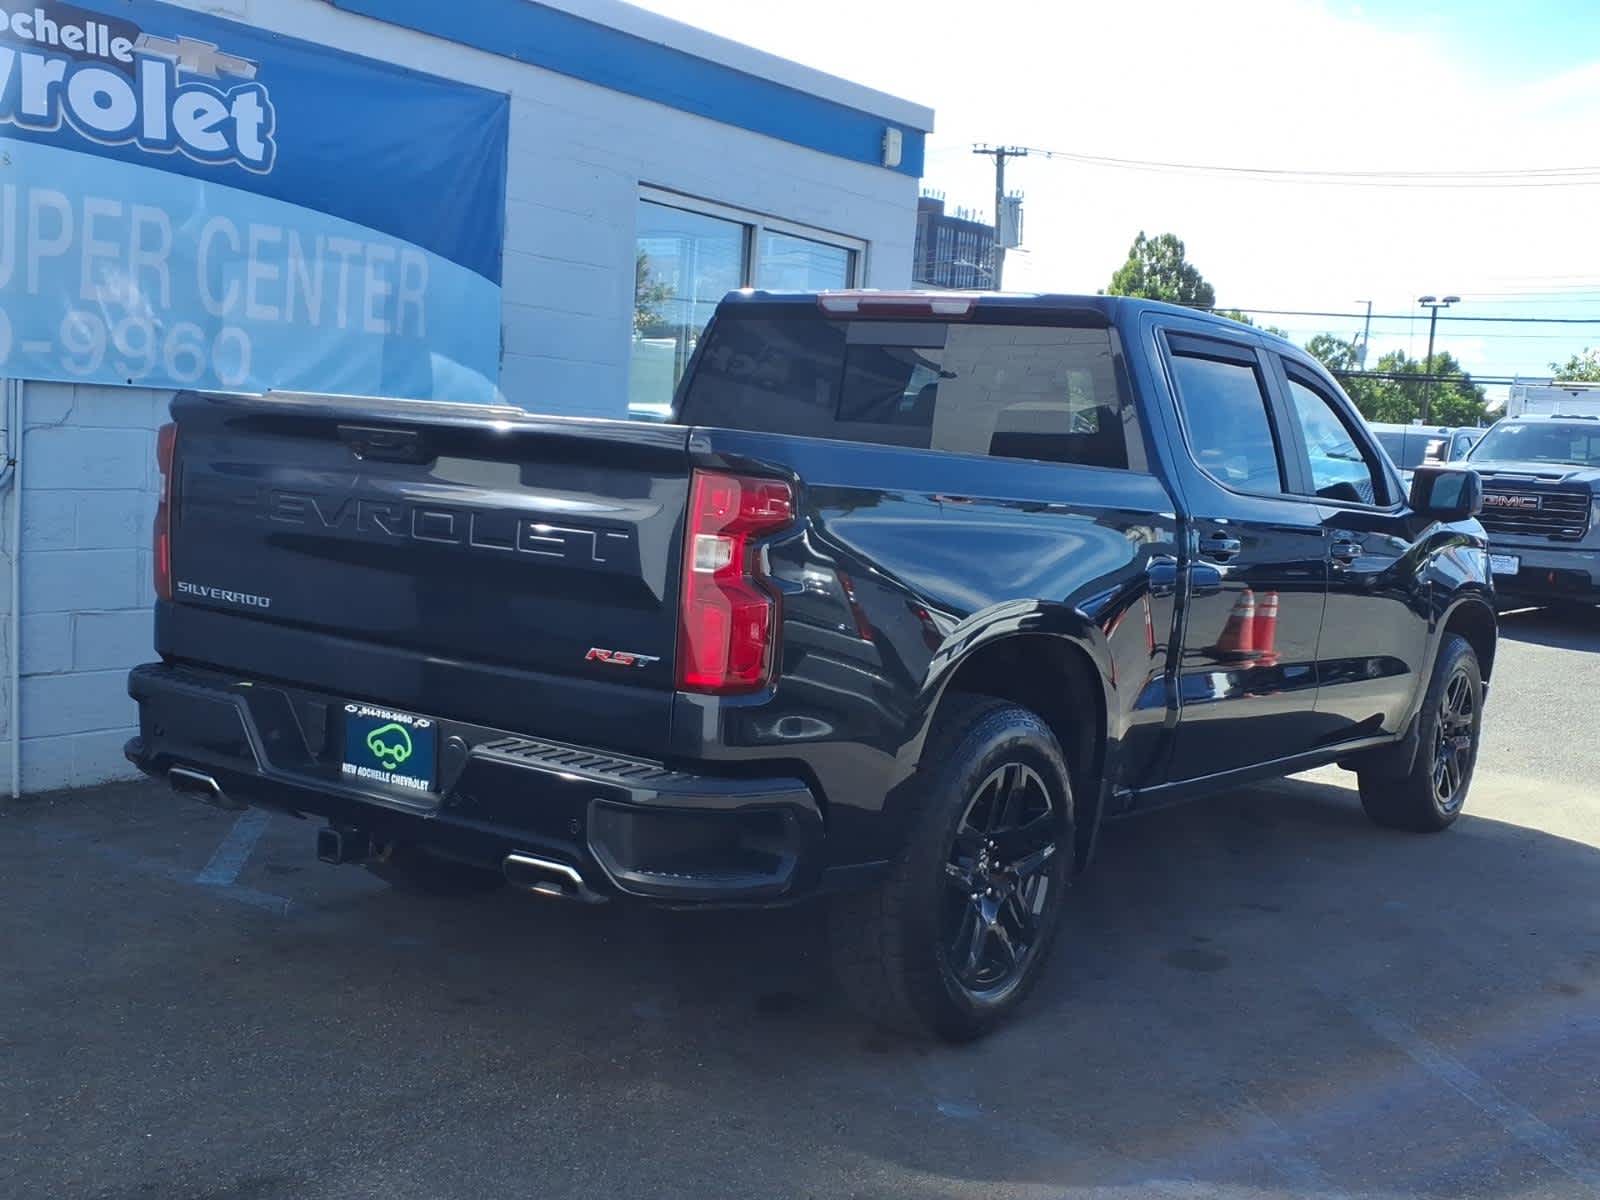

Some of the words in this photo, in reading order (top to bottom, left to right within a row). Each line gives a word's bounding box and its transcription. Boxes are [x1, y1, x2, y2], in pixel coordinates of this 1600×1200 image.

[199, 215, 430, 337] CENTER
[0, 306, 252, 387] -9960
[1481, 494, 1538, 508] GMC
[240, 484, 631, 562] EVROLET
[177, 581, 271, 608] SILVERADO
[584, 647, 661, 668] RST
[342, 762, 357, 775] NEW
[357, 766, 390, 783] ROCHELLE
[391, 774, 429, 791] CHEVROLET
